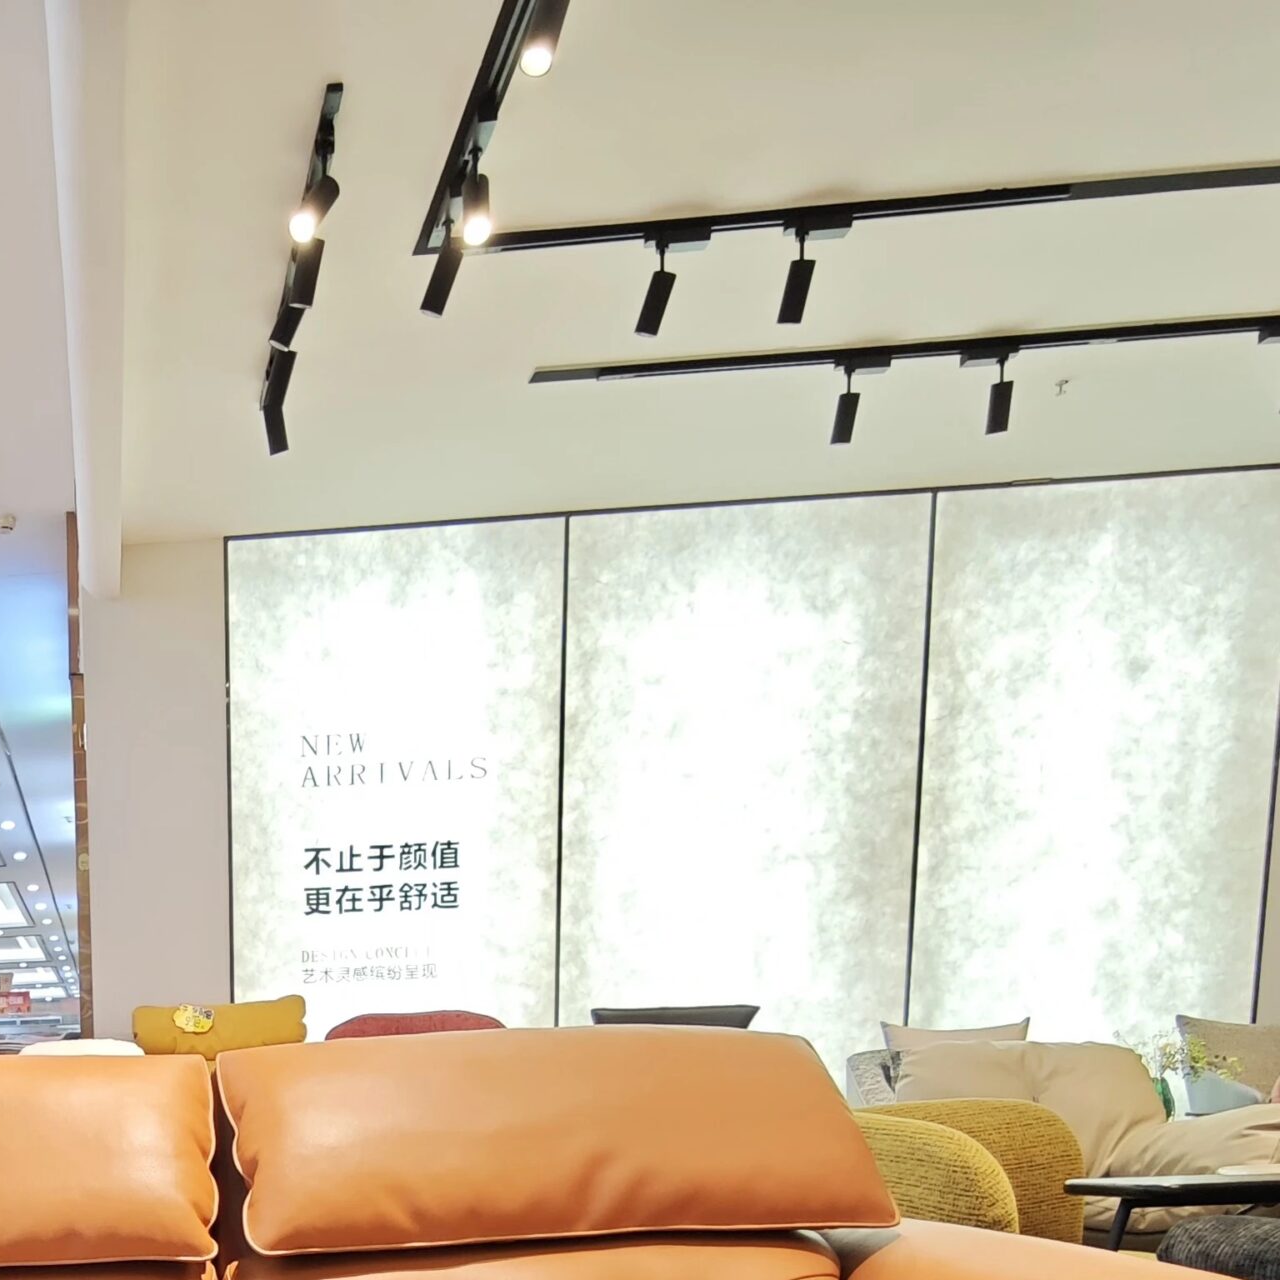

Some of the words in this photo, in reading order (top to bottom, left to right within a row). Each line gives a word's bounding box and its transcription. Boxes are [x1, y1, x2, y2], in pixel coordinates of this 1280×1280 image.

[300, 733, 365, 758] NEW
[301, 757, 488, 788] ARRIVALS
[303, 840, 460, 875] 不止于颜值
[303, 881, 460, 915] 更在乎舒适
[301, 963, 438, 984] 艺术灵感缤纷呈现
